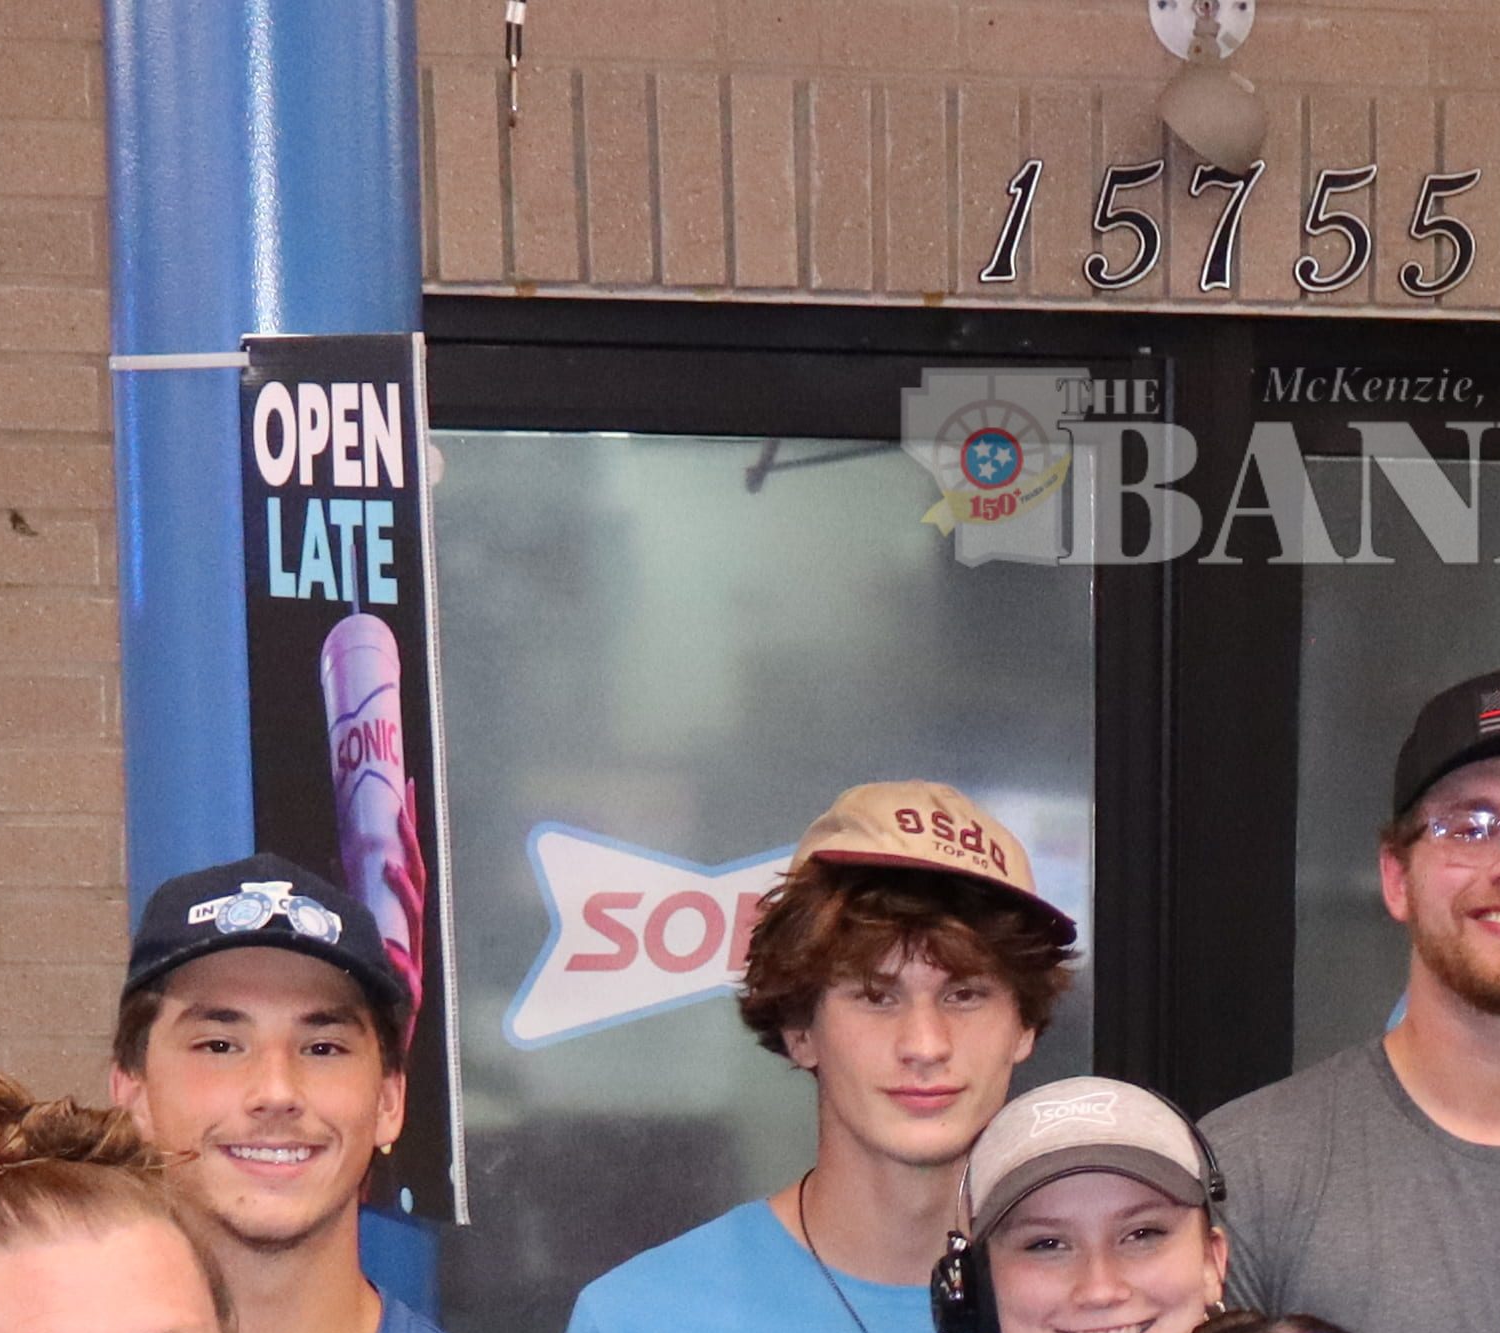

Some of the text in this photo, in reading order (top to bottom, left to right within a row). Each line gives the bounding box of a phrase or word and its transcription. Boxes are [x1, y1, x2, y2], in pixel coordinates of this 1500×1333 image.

[980, 160, 1482, 297] 15755
[253, 381, 404, 488] OPEN
[267, 497, 398, 604] LATE
[336, 718, 401, 775] SONIC
[933, 841, 965, 858] TOP
[1041, 1102, 1107, 1124] SONIC
